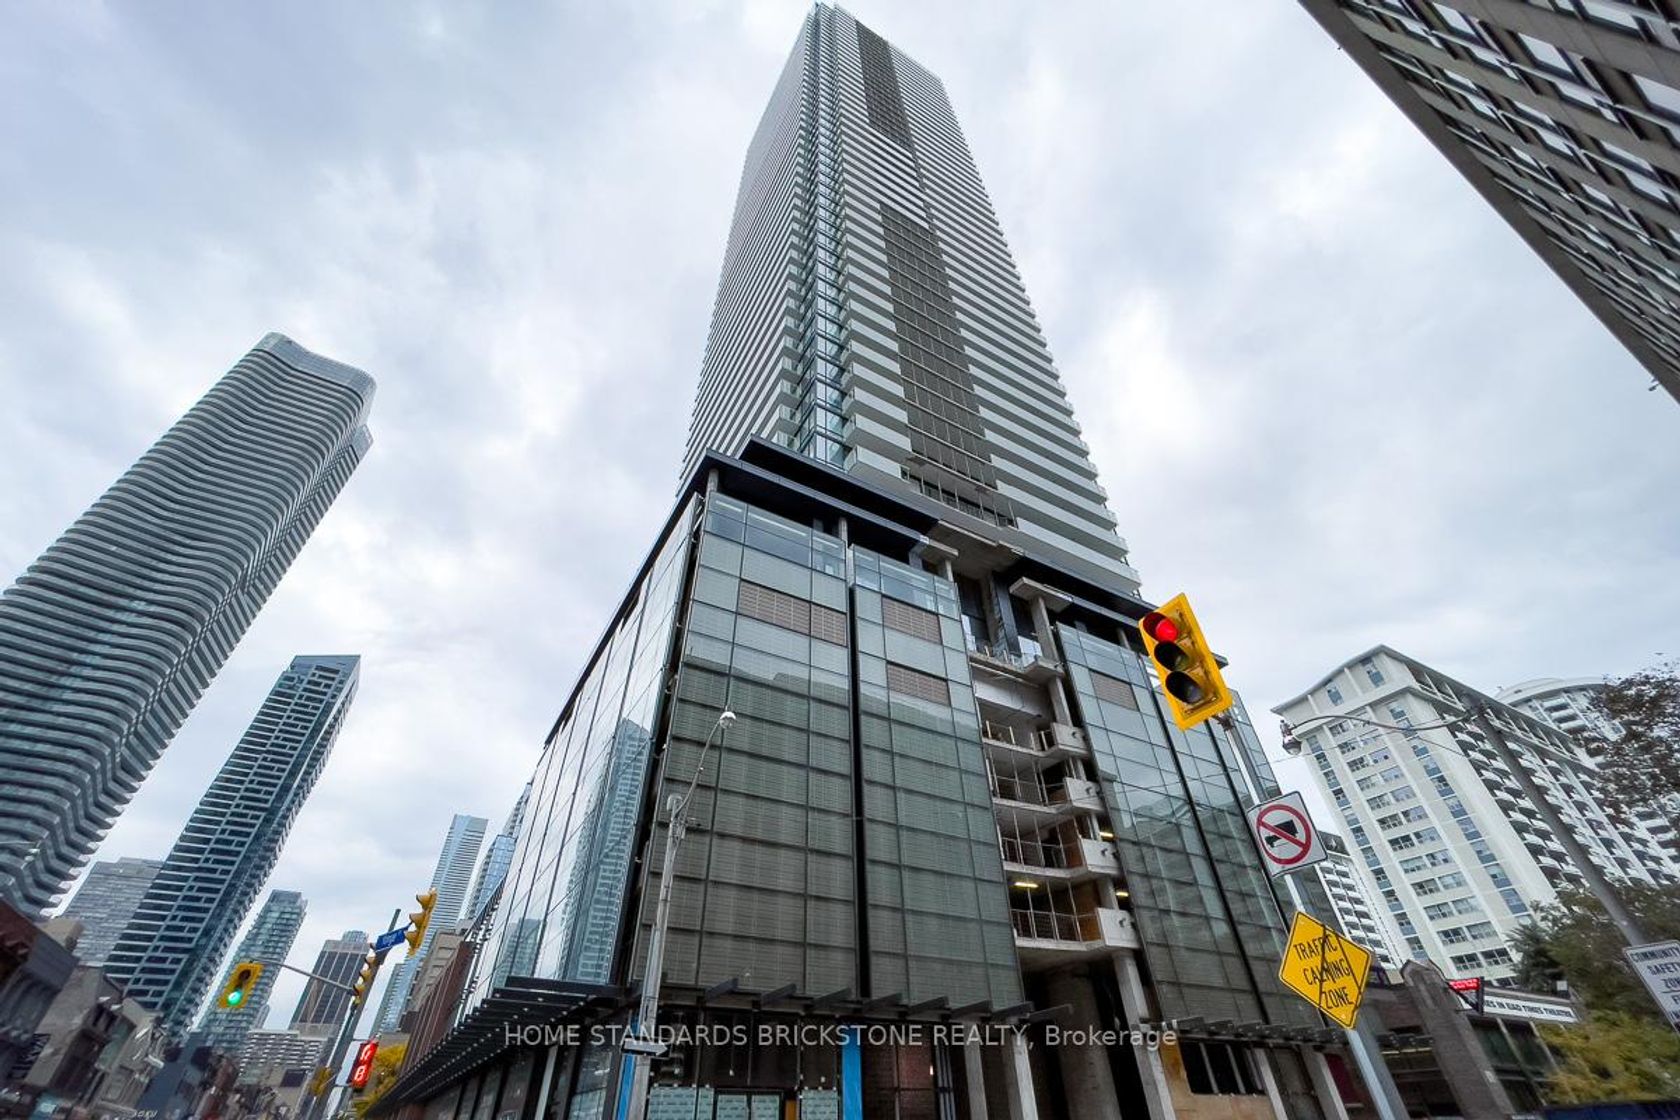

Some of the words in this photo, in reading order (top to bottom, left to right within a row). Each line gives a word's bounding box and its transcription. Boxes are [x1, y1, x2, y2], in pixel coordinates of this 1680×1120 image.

[1293, 933, 1338, 961] TRAFFIC
[1303, 958, 1351, 986] CALMING
[1321, 986, 1355, 1010] ZONE
